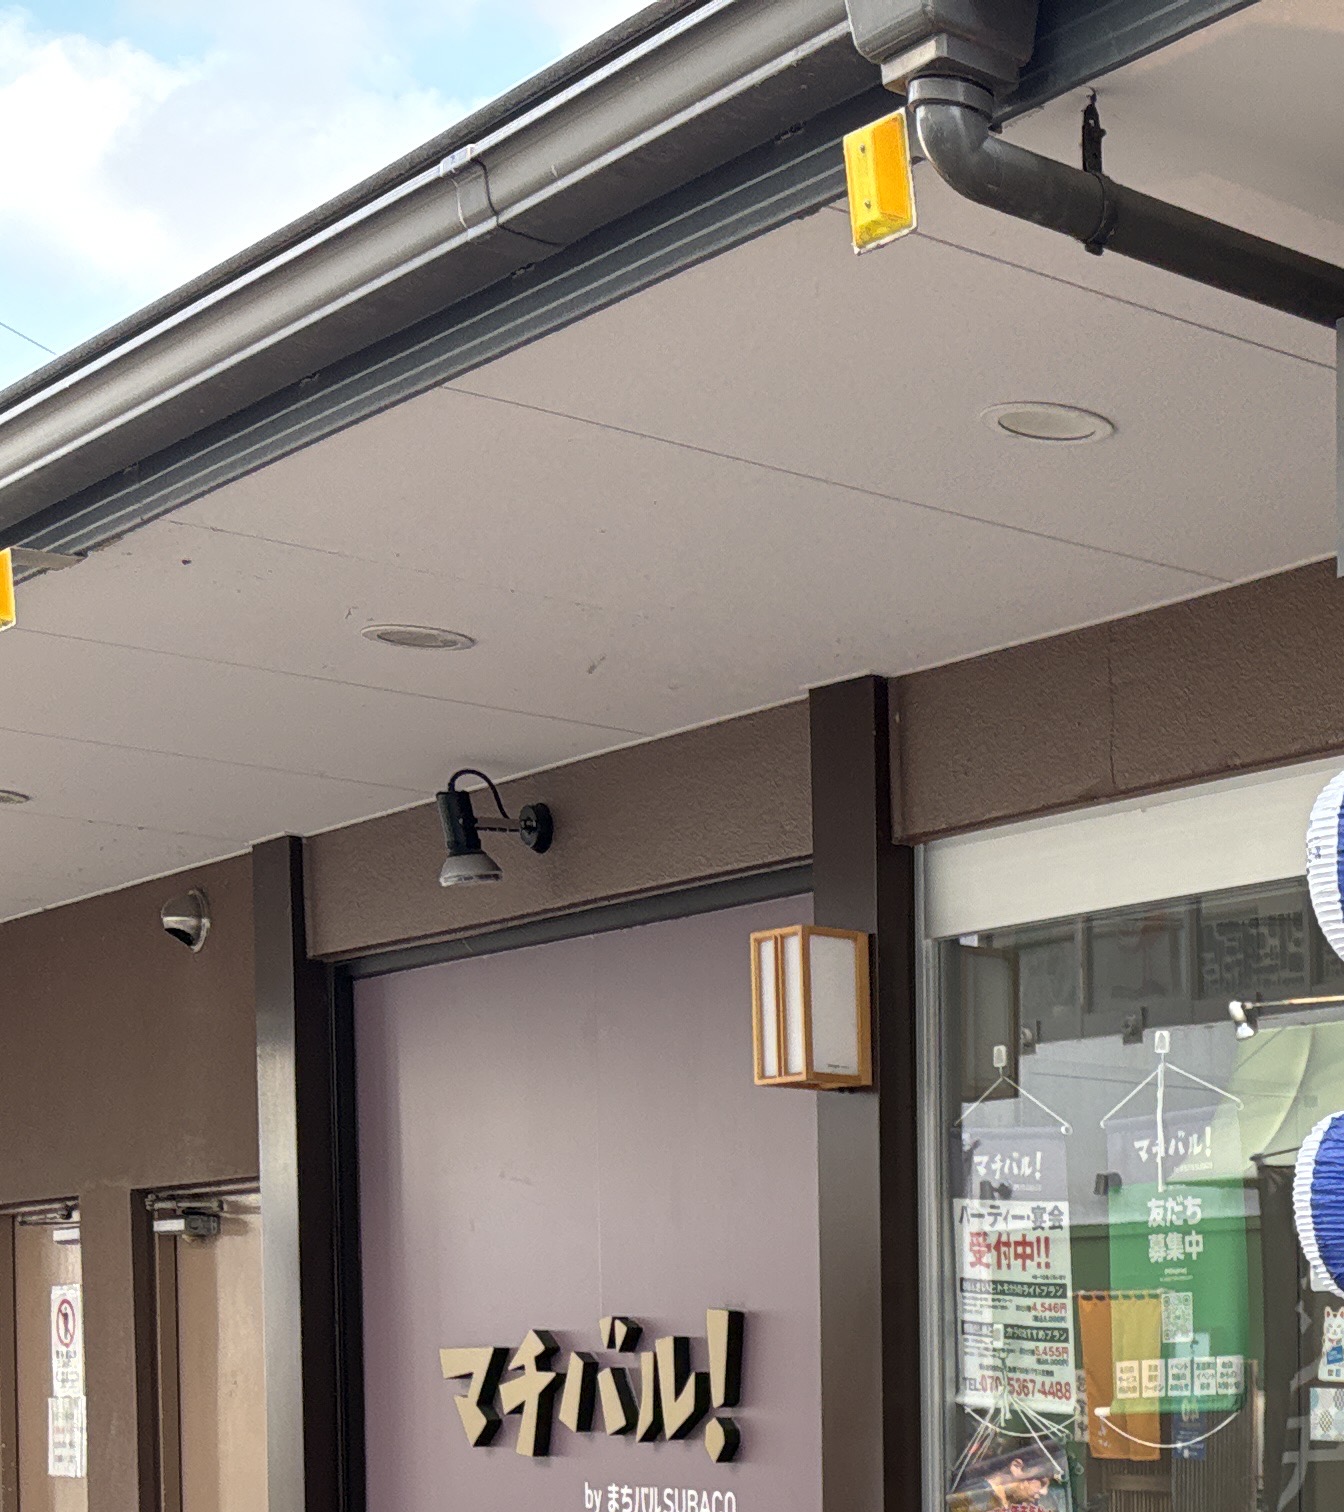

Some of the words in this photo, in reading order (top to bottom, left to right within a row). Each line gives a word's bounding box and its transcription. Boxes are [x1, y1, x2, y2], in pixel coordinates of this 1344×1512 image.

[1147, 1194, 1202, 1227] 友だち
[969, 1231, 1051, 1272] 受付中!!
[1148, 1230, 1204, 1263] 募集中
[439, 1308, 745, 1463] マチバル!
